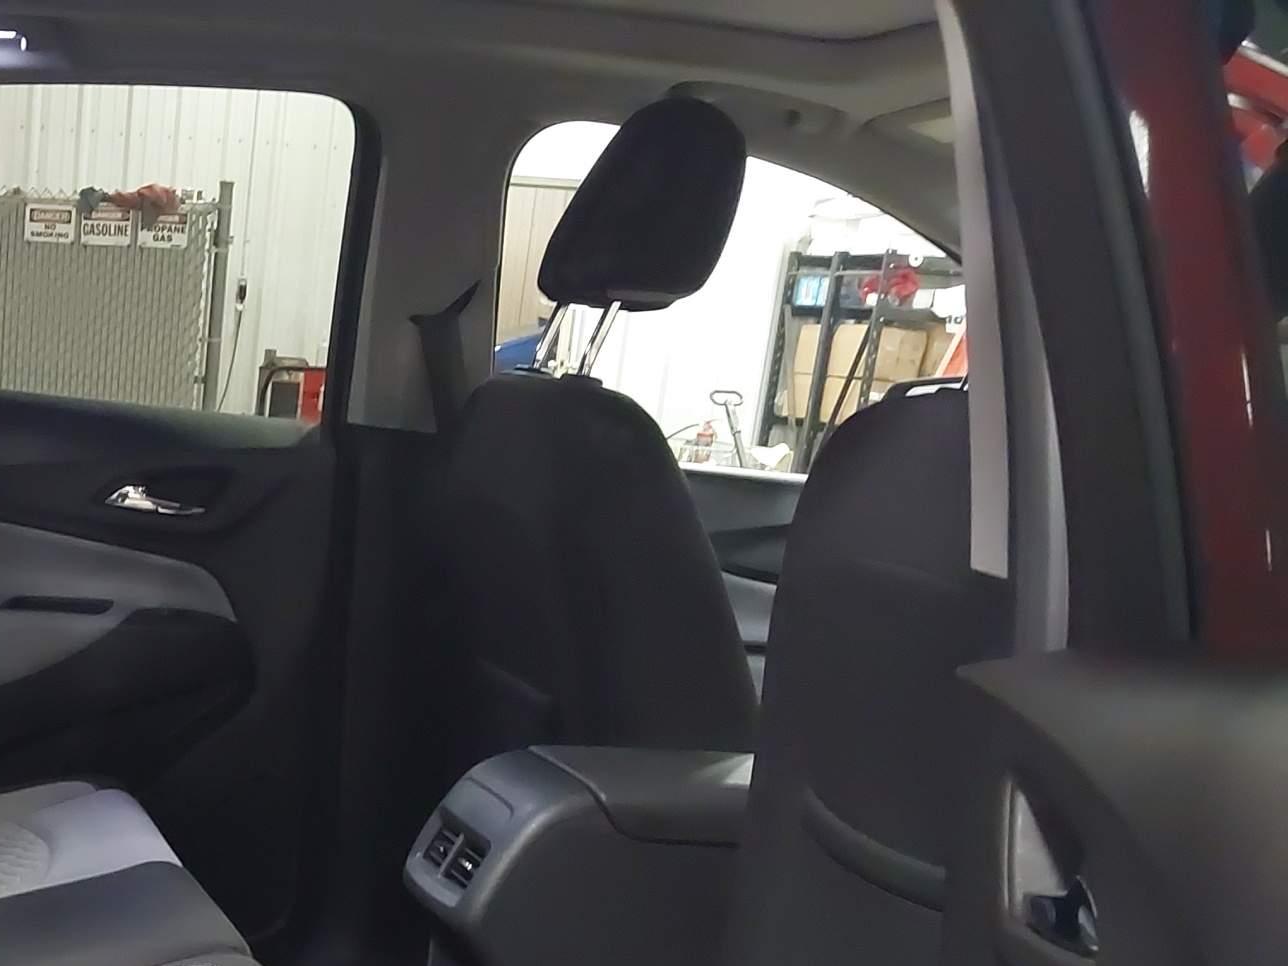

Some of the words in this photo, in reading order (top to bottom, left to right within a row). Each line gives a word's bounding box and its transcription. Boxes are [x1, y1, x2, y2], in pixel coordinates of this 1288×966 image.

[44, 223, 56, 231] NO
[83, 223, 129, 236] GASOLINE
[152, 234, 173, 242] GAS
